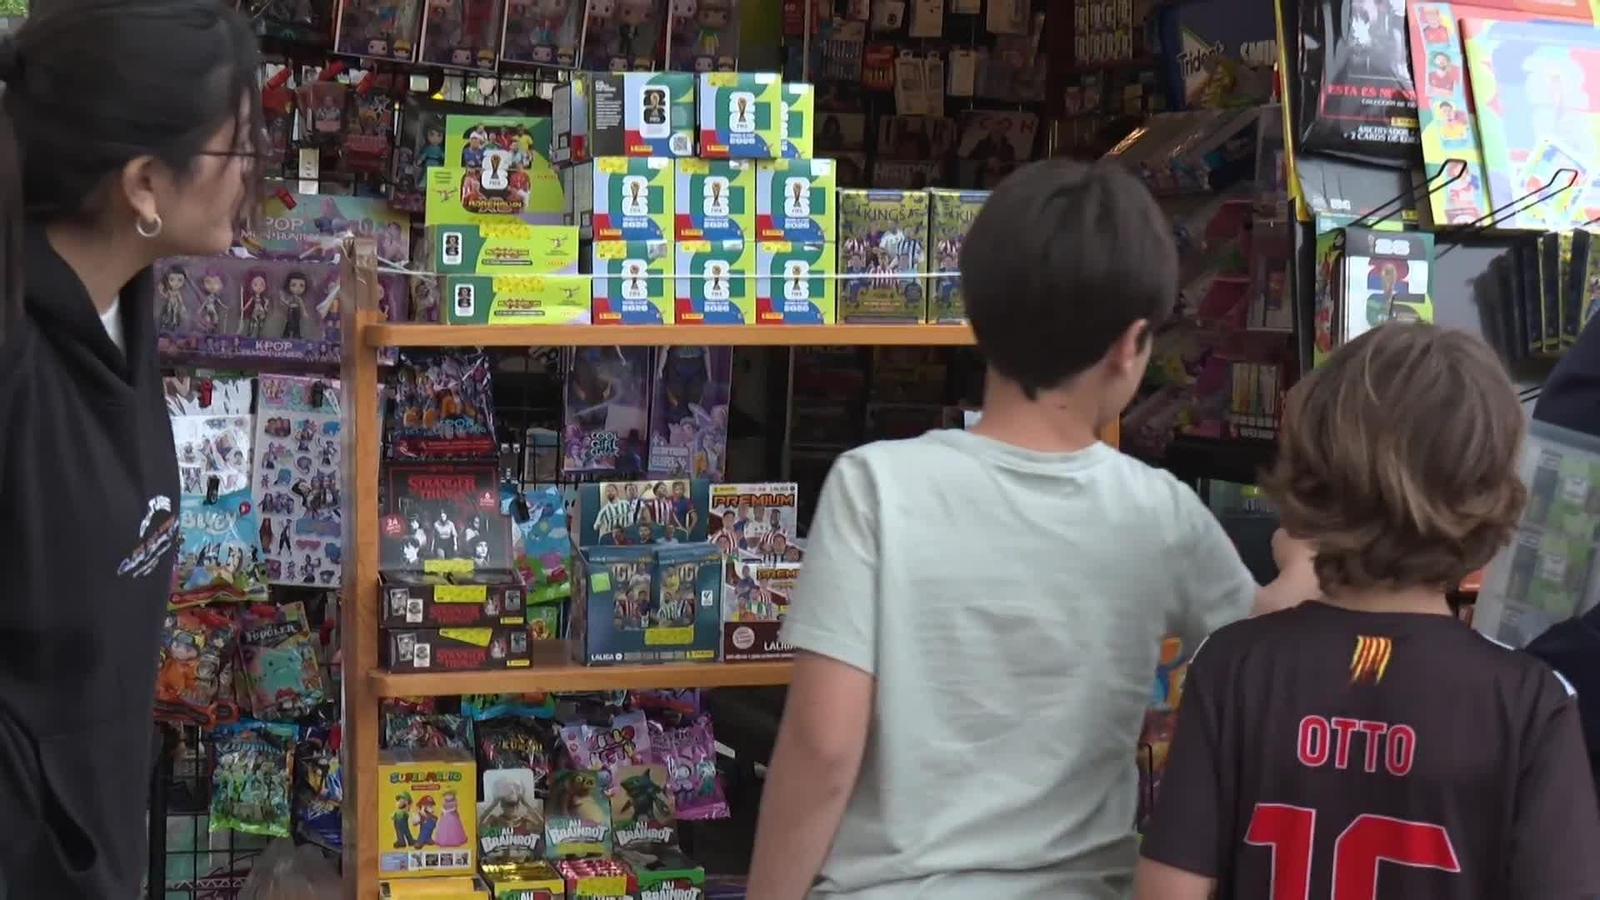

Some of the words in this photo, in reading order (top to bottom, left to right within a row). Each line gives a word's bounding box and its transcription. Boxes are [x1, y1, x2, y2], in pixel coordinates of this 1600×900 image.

[1328, 84, 1358, 96] ESTA
[255, 340, 293, 351] KPOP
[408, 477, 477, 491] STRANGER
[712, 493, 796, 508] PREMIUM
[757, 568, 800, 580] PREM
[764, 641, 793, 651] LALI
[591, 653, 615, 661] LALIGA
[1297, 715, 1416, 776] OTTO
[389, 772, 427, 783] SUPER
[426, 771, 462, 783] MARIO
[548, 826, 609, 846] BRAINROT
[615, 827, 674, 846] BRAINROT
[480, 833, 541, 853] BRAINROT
